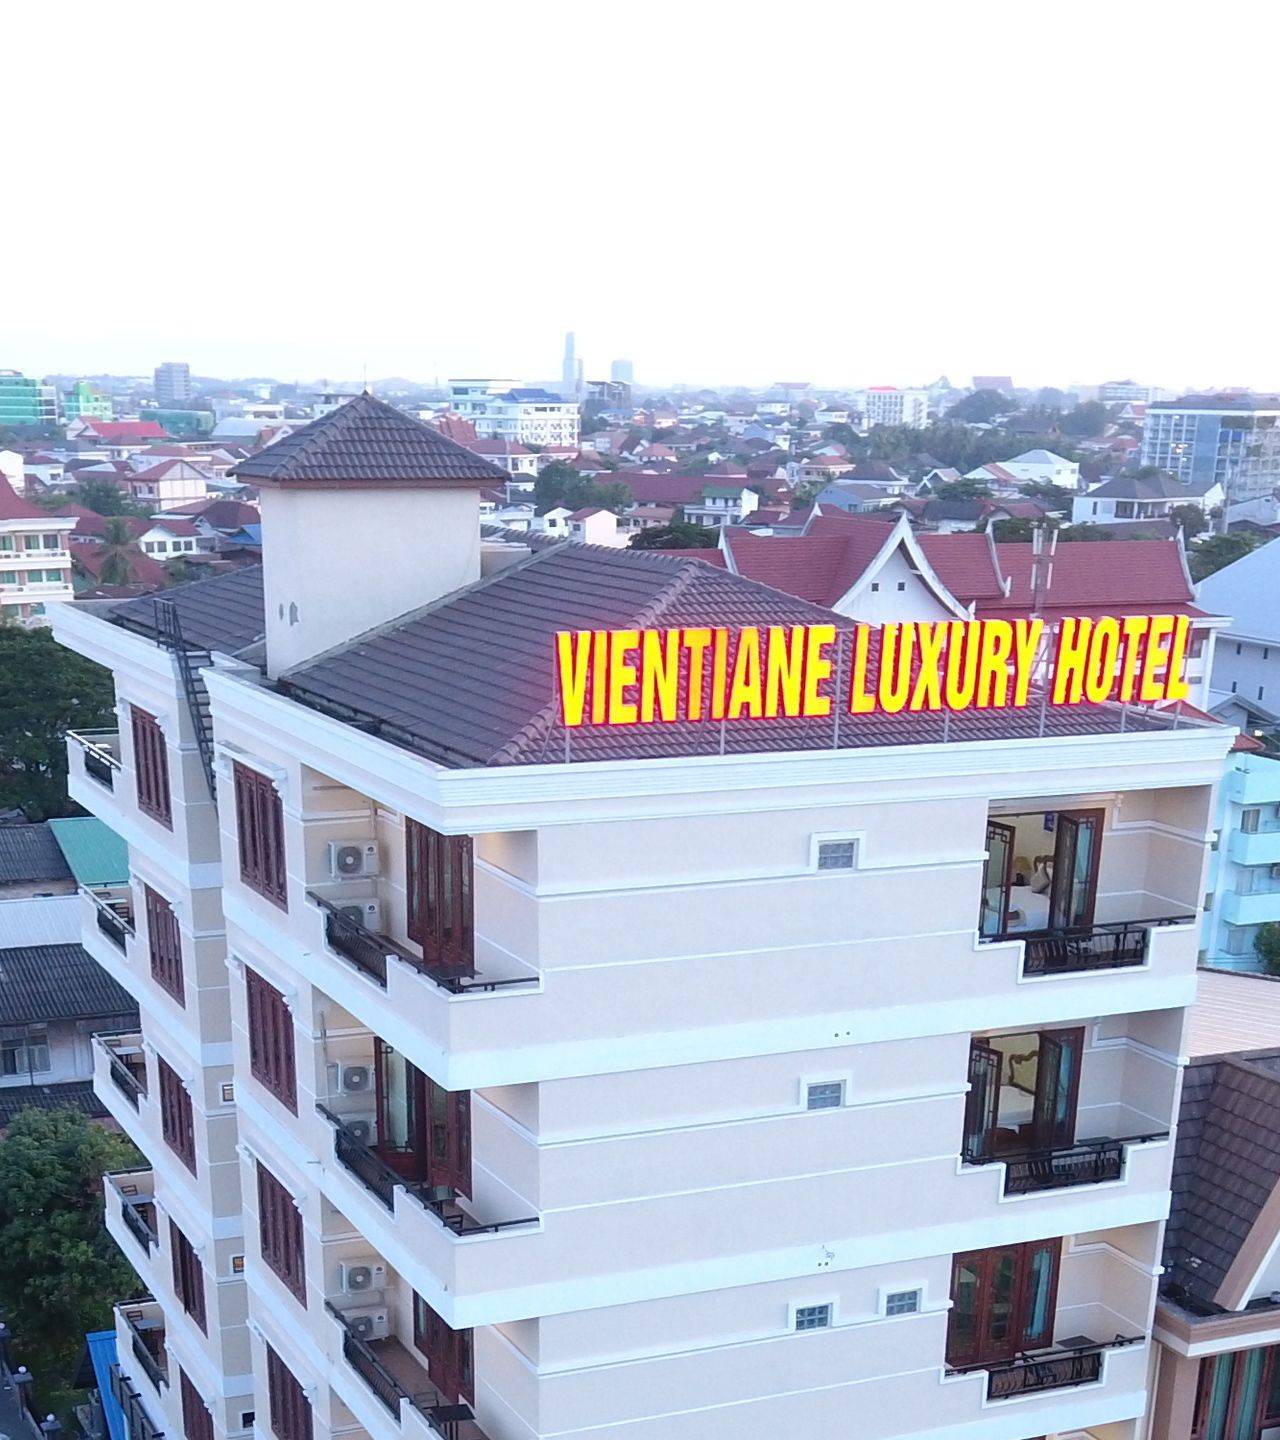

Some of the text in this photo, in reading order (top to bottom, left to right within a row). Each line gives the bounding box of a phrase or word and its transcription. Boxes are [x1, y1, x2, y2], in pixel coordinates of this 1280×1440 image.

[556, 614, 1192, 726] VIENTIANE LUXURY HOTEL
